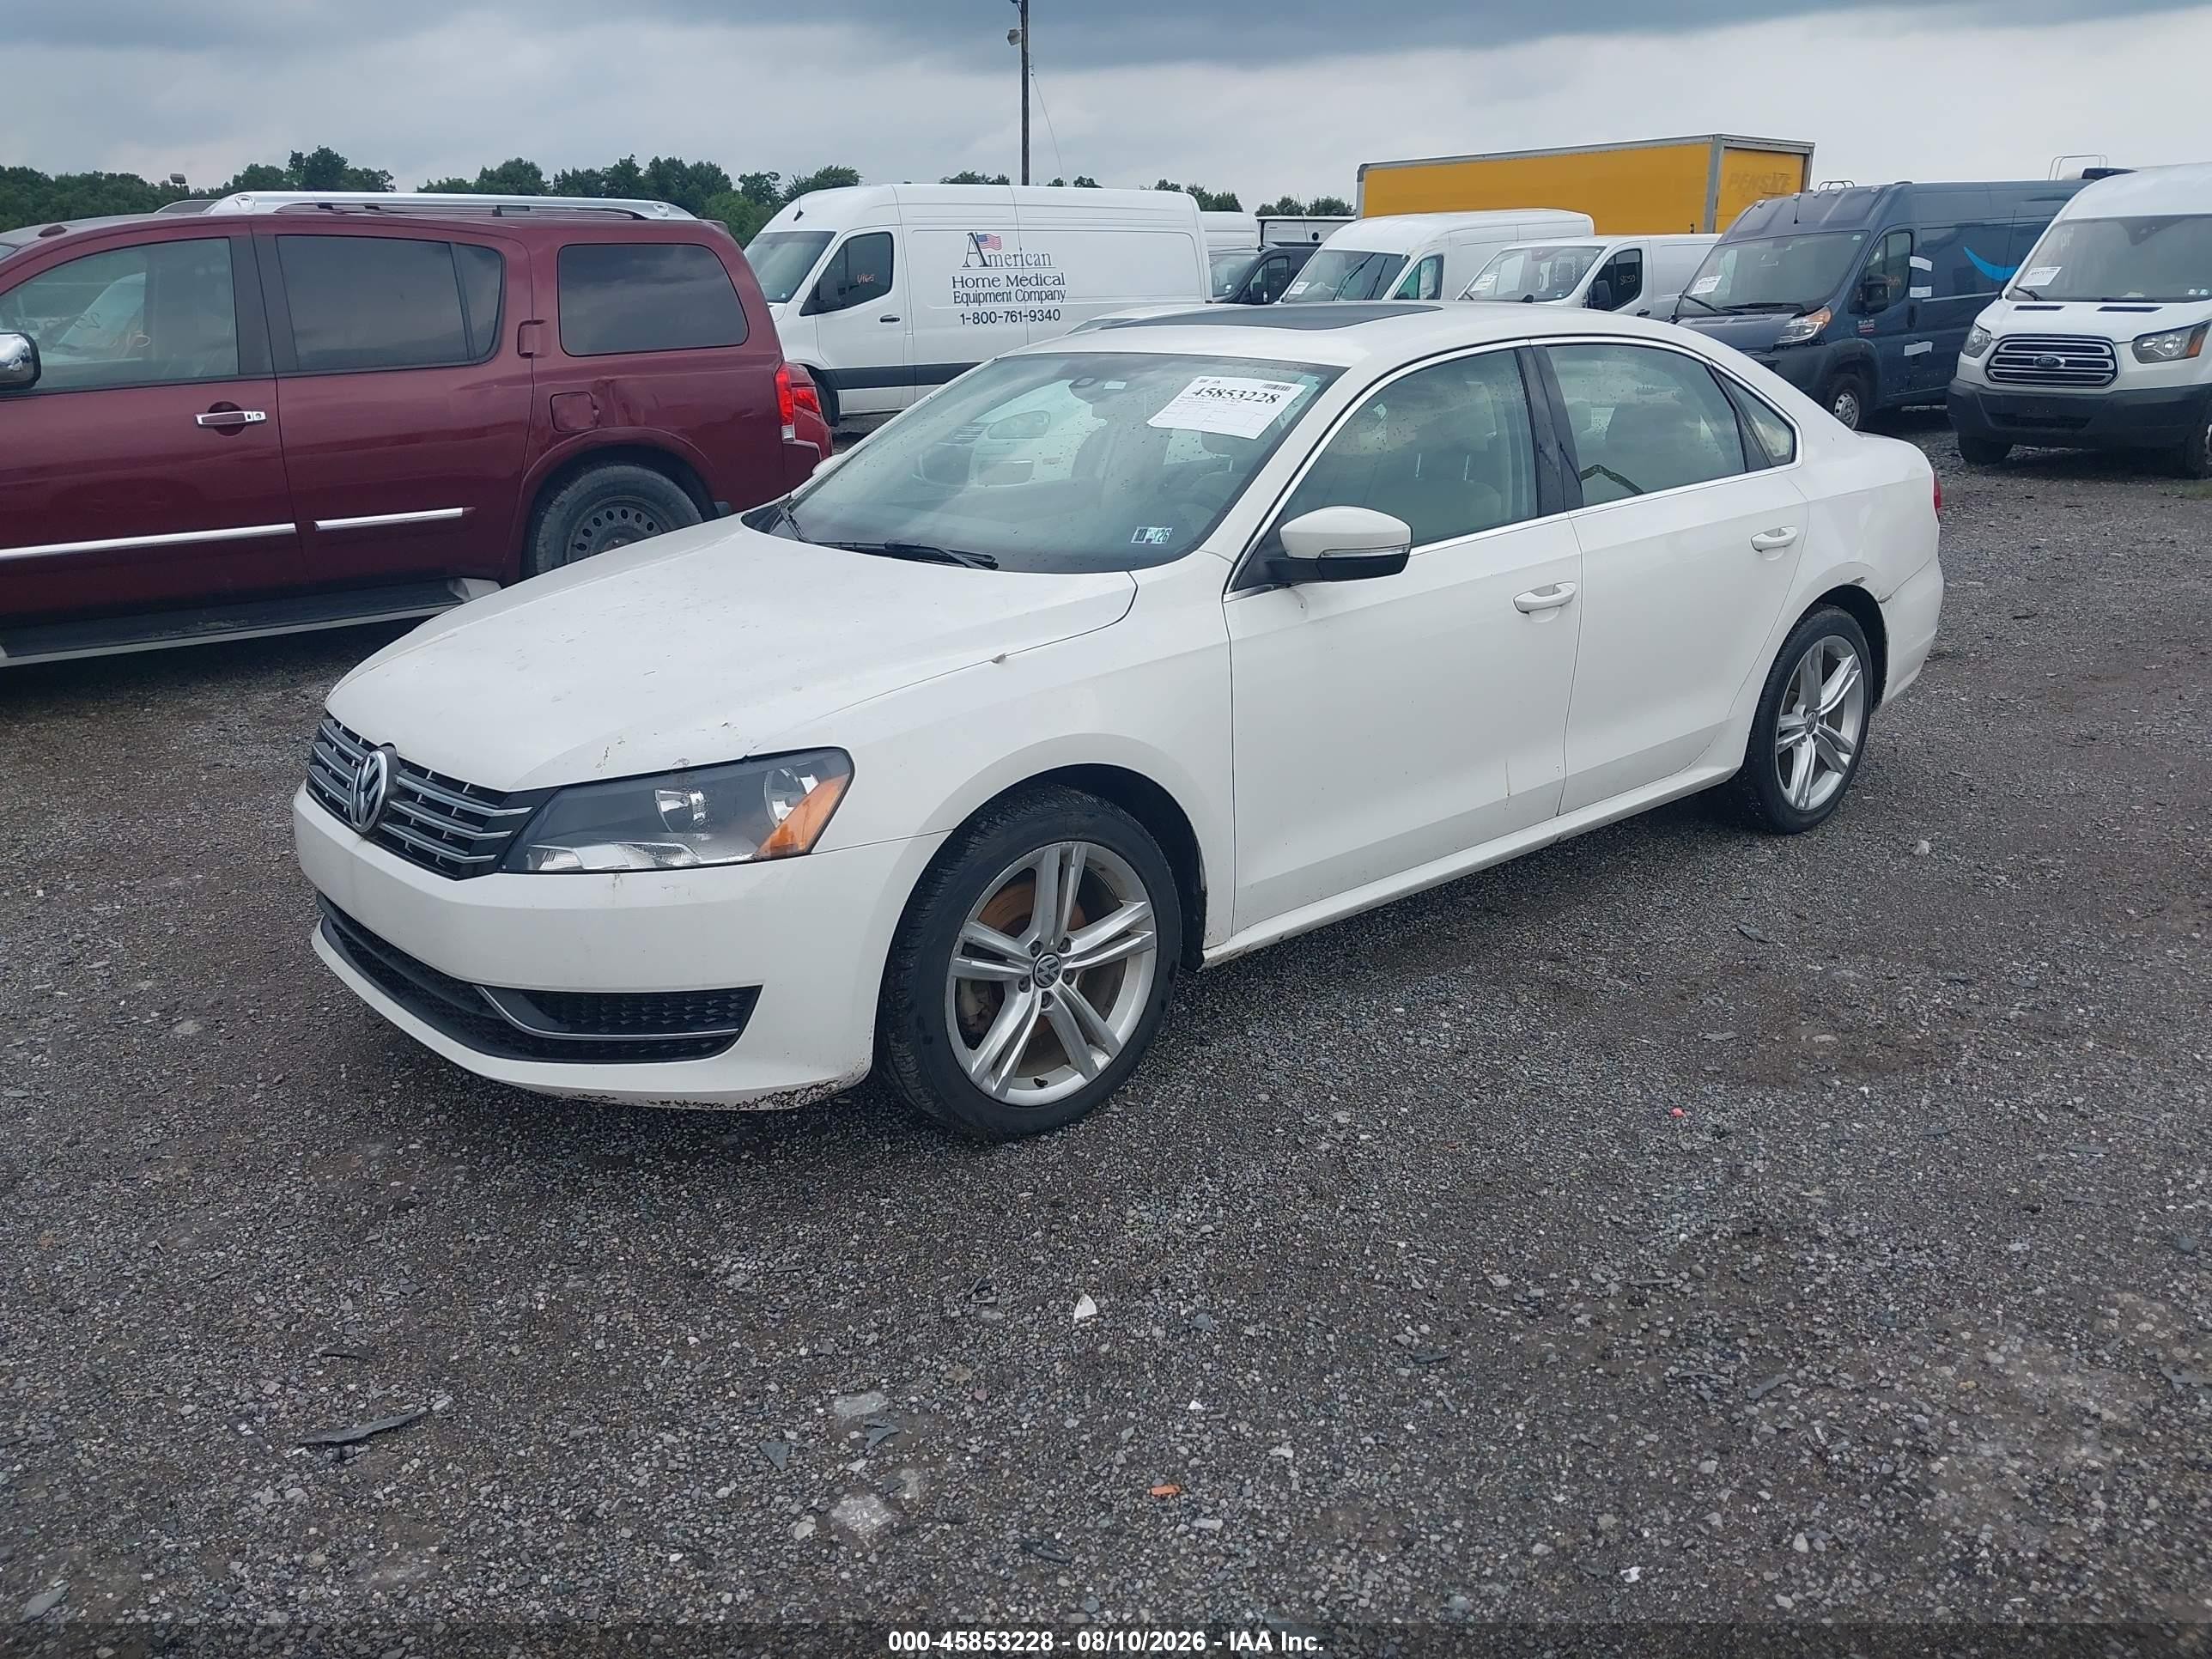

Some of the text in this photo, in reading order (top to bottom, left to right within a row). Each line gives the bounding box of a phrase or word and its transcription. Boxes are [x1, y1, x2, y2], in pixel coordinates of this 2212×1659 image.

[961, 231, 1053, 268] American
[951, 271, 1066, 289] Home Medical
[952, 289, 1066, 307] Equipment Company
[959, 308, 1061, 325] 1-800-761-9340
[1191, 386, 1281, 404] 45853228
